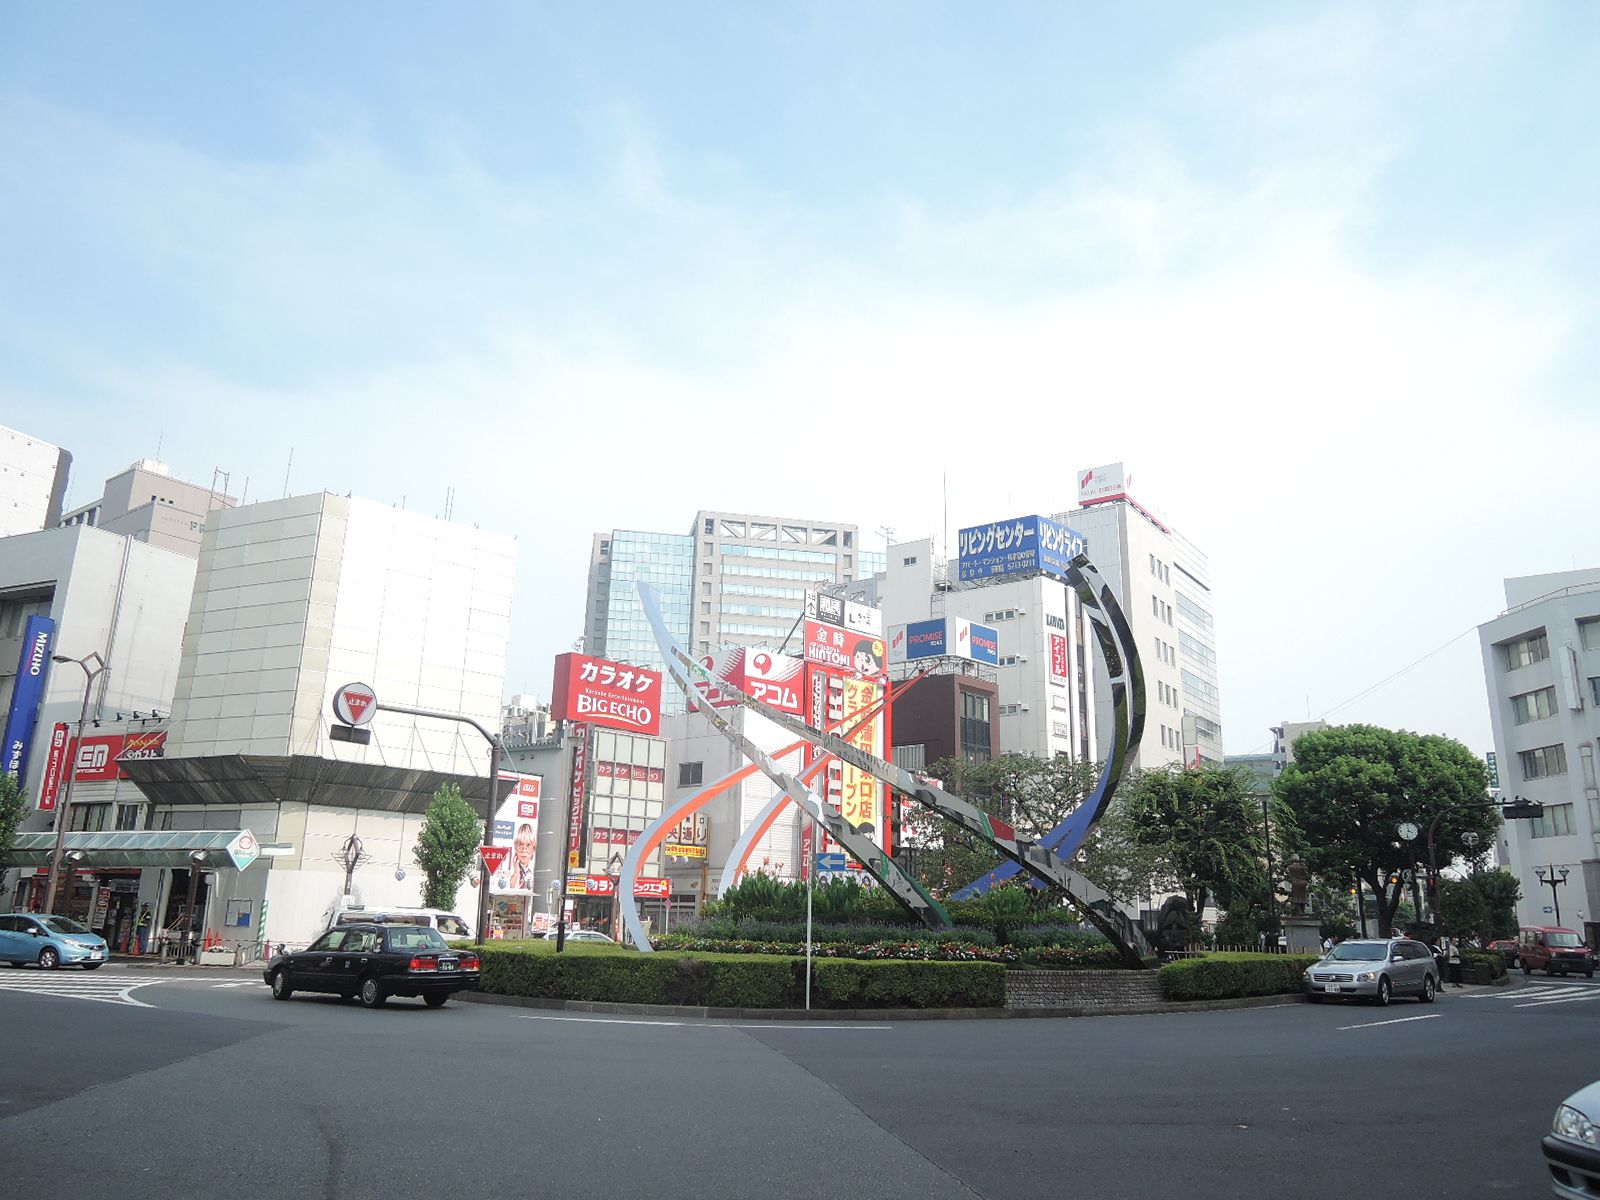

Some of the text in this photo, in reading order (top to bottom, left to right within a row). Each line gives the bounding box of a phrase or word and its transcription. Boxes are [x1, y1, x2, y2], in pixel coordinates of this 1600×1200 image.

[960, 521, 1035, 558] リビングセンター
[816, 627, 845, 648] 金時
[909, 631, 943, 645] PROMISE
[972, 635, 997, 651] PROMISE
[30, 631, 48, 676] MIZUHO
[580, 661, 653, 693] カラオケ
[751, 681, 798, 709] アコム
[577, 694, 652, 725] BIG ECHO
[573, 727, 585, 783] カラオケ
[523, 784, 535, 792] au
[485, 852, 503, 860] 止まれ
